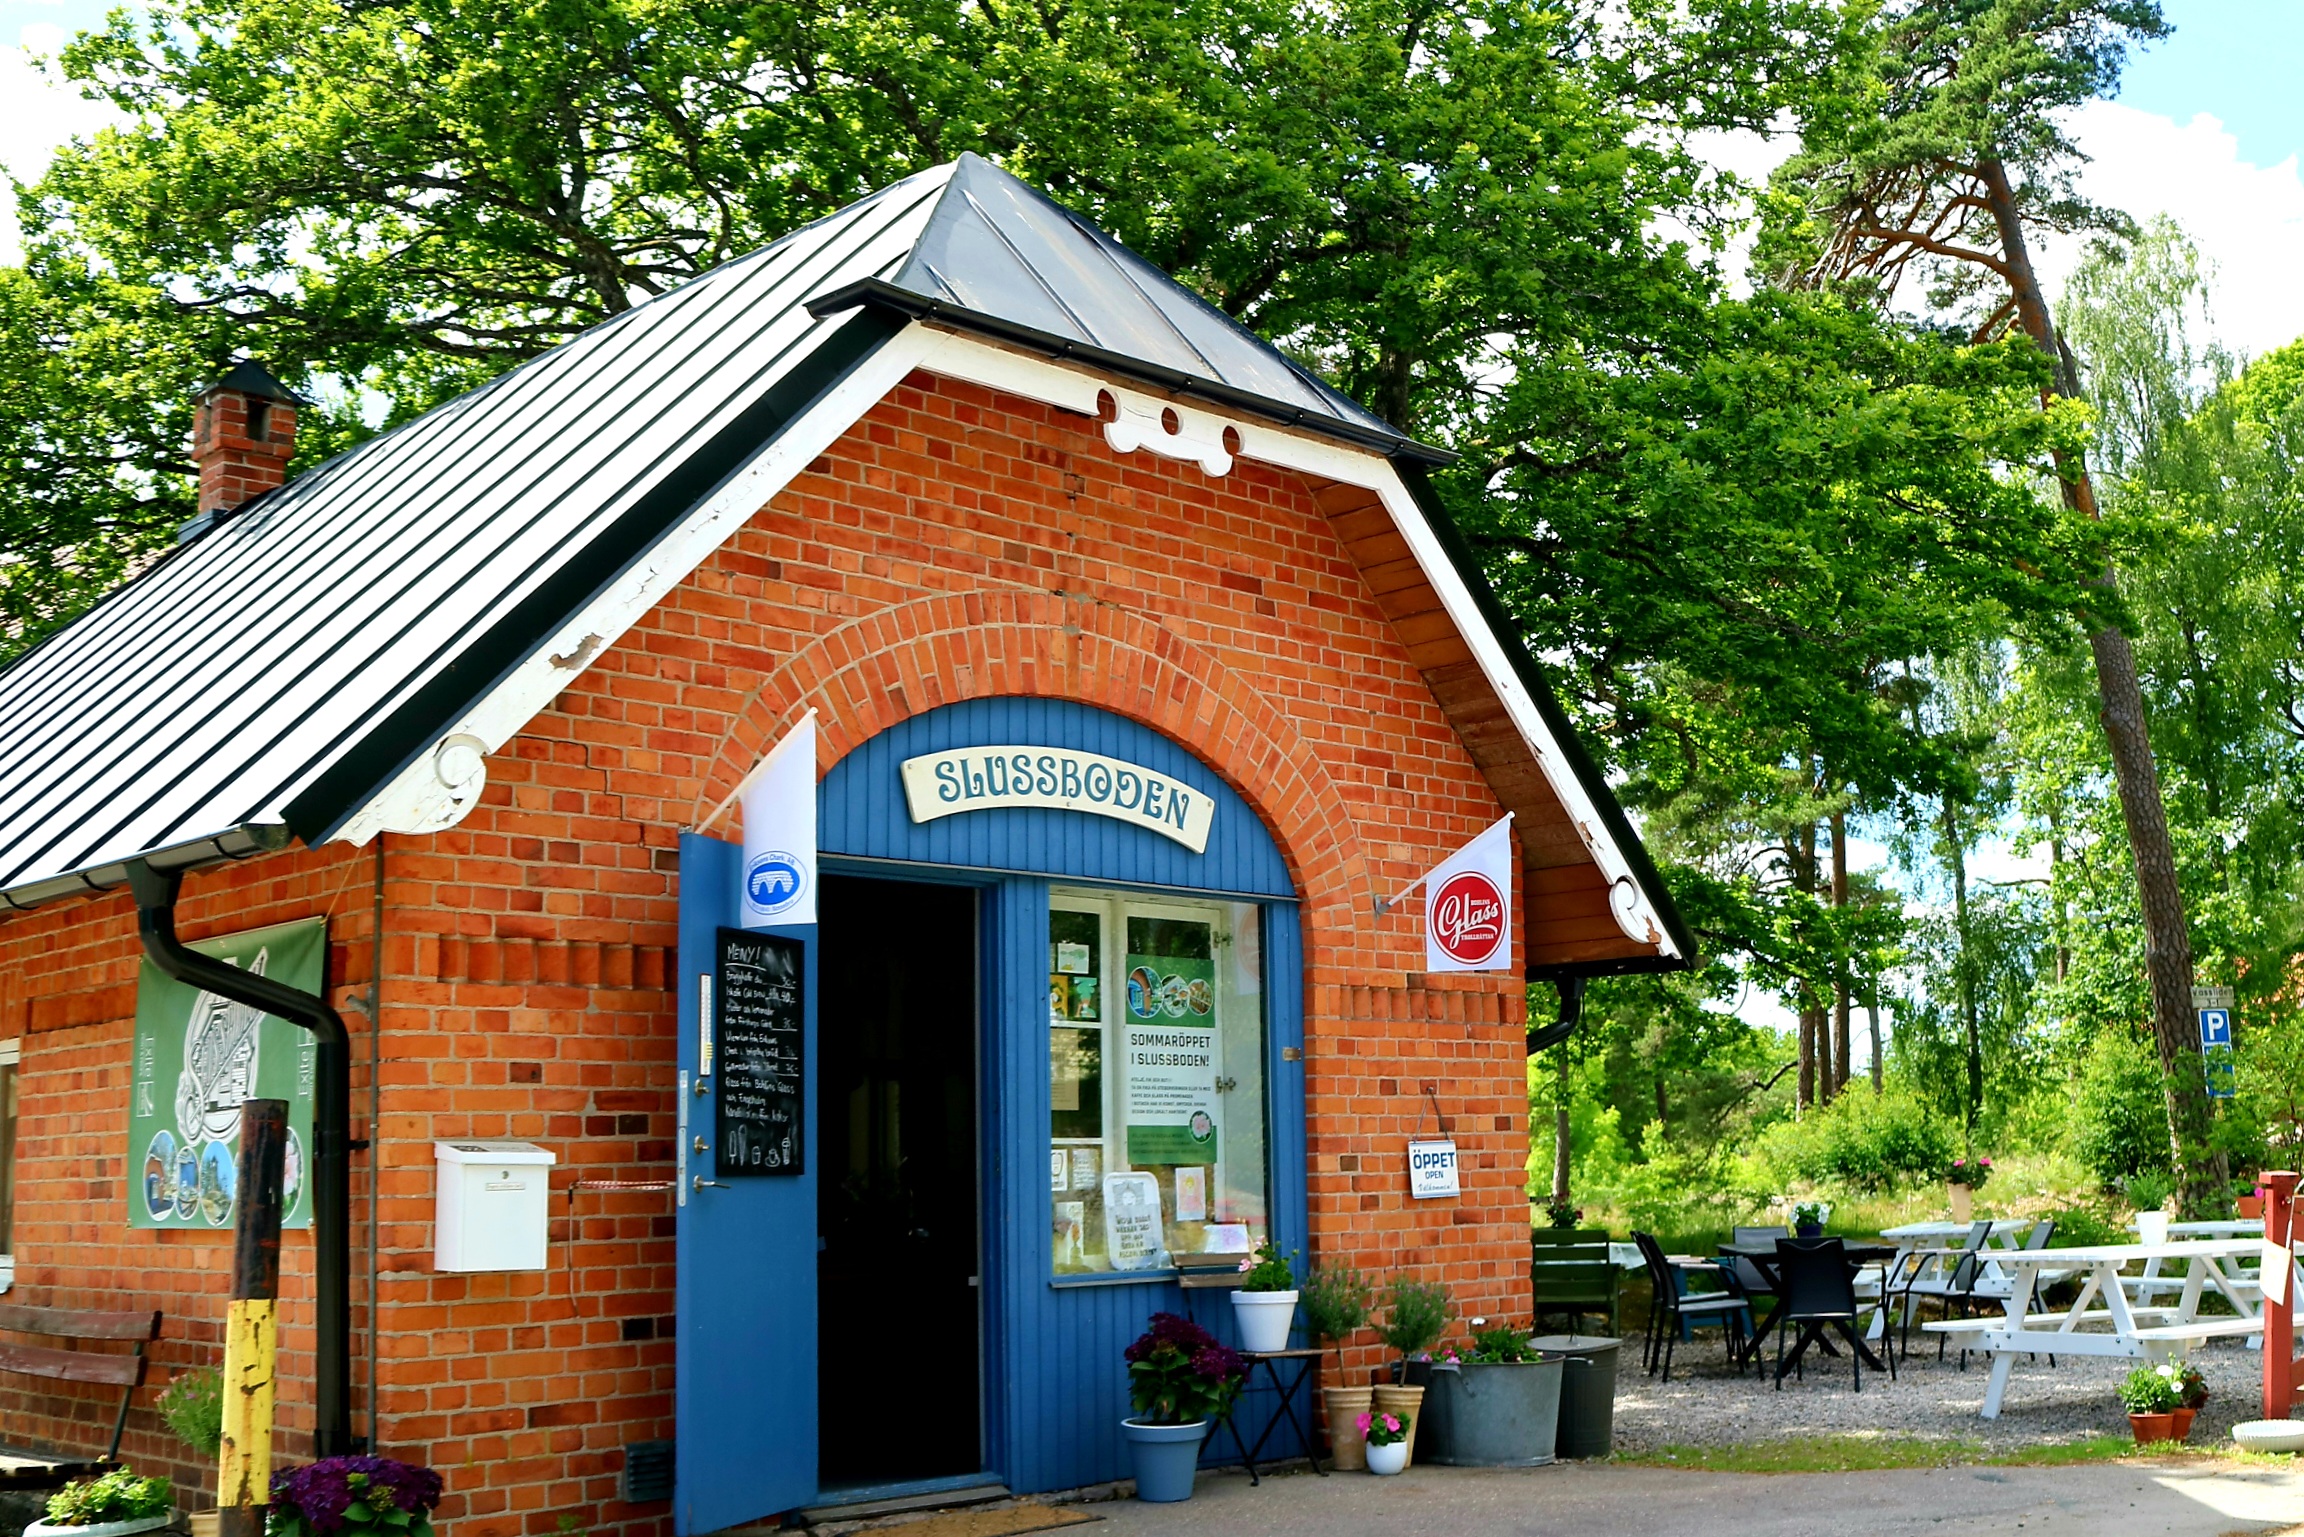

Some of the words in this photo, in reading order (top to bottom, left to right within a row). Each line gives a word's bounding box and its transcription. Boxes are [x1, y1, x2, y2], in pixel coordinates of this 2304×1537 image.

[934, 754, 1191, 831] SLUSSBODEN
[1438, 892, 1499, 950] Glass
[727, 942, 761, 966] MENY!
[2207, 1012, 2224, 1041] P
[1131, 1032, 1211, 1048] SOMMARÖPPET
[1131, 1053, 1135, 1065] I
[1137, 1053, 1210, 1067] SLUSSBODEN!
[1413, 1149, 1455, 1170] ÖPPET
[1425, 1170, 1444, 1180] OPEN
